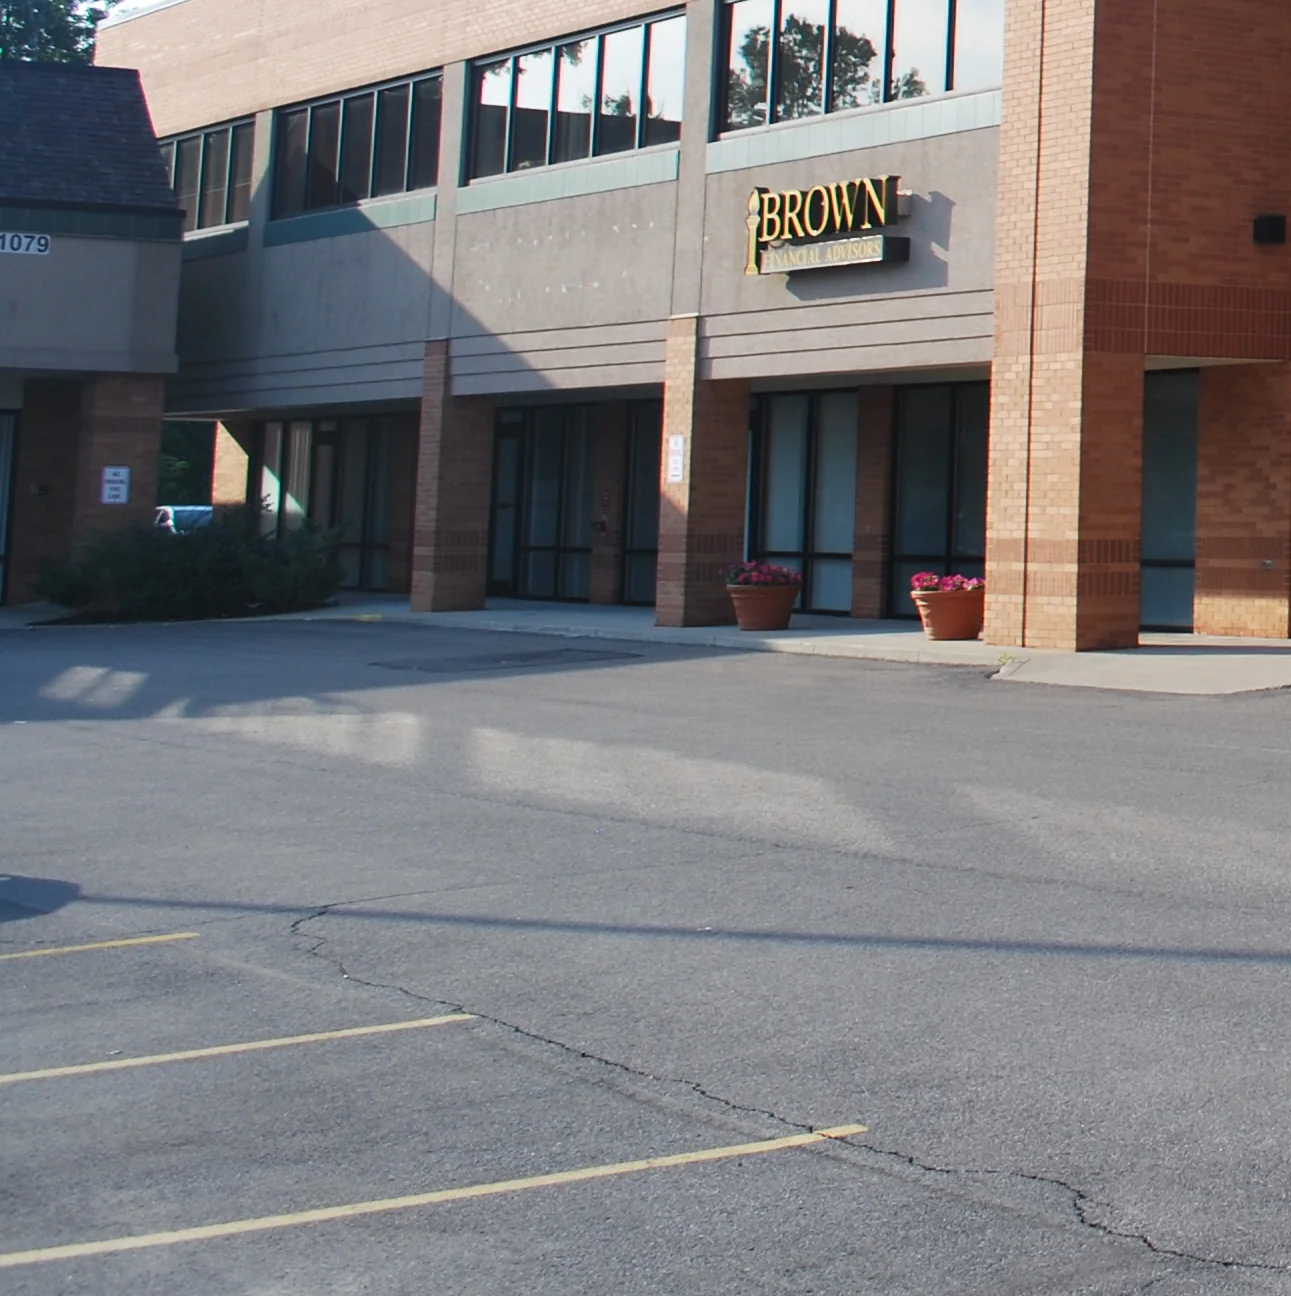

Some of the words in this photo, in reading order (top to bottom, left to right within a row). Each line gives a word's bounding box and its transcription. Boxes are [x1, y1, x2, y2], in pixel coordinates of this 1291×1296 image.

[758, 175, 889, 242] BROWN
[0, 234, 49, 253] 1079
[765, 245, 822, 269] FINANCIAL
[824, 241, 881, 264] ADVISORS
